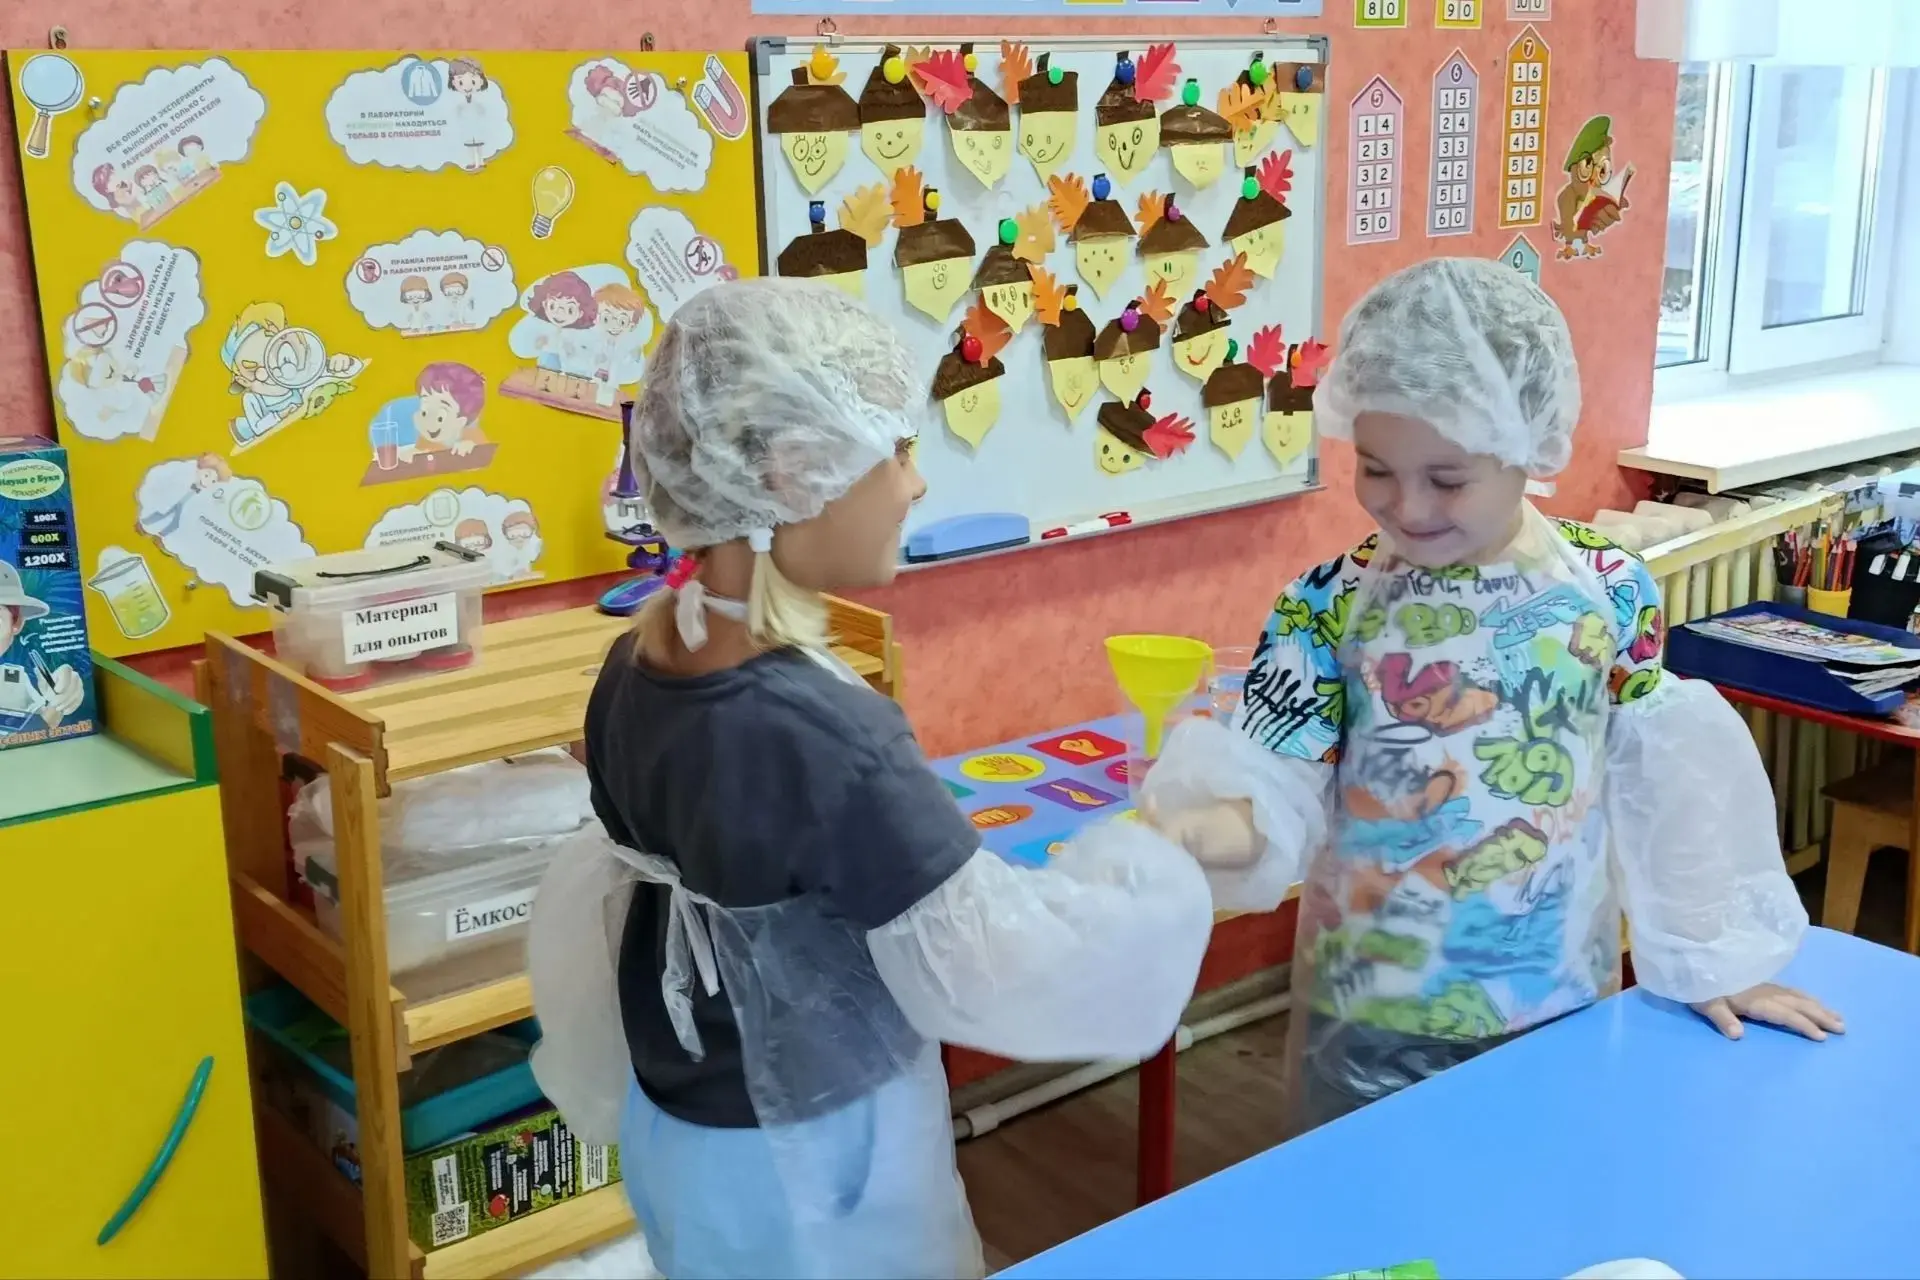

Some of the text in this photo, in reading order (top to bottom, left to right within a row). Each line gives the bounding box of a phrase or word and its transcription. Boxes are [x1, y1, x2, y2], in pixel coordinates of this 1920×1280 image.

[1368, 2, 1395, 16] 8 0
[1447, 3, 1471, 17] 9 0
[1517, 66, 1539, 79] 1 6
[1444, 92, 1467, 106] 1 5
[1515, 89, 1538, 103] 2 5
[121, 119, 151, 143] ОПЫТЫ
[151, 115, 158, 123] И
[158, 75, 216, 118] ЭКСПЕРИМЕНТЫ
[170, 100, 199, 122] ТОЛЬКО
[199, 94, 206, 102] С
[368, 110, 425, 118] ЛАБОРАТОРИИ
[170, 97, 221, 136] ВОСПИТАТЕЛЯ
[1443, 117, 1465, 130] 2 4
[1514, 113, 1537, 126] 3 4
[1363, 118, 1390, 133] 1 4
[1442, 140, 1465, 154] 3 3
[1512, 136, 1535, 149] 4 3
[1362, 143, 1389, 157] 2 3
[1440, 164, 1464, 177] 4 2
[1511, 159, 1534, 172] 5 2
[1361, 167, 1388, 183] 3 2
[1440, 188, 1461, 201] 5 1
[1510, 182, 1532, 195] 6 1
[1360, 192, 1386, 206] 4 1
[1439, 211, 1462, 225] 6 0
[1510, 204, 1532, 218] 7 0
[1359, 216, 1387, 231] 5 0
[390, 254, 468, 266] ПРАВИЛА ПОВЕДЕНИЯ
[390, 265, 441, 275] ЛАБОРАТОРИИ
[442, 264, 457, 272] ДЛЯ
[125, 301, 150, 350] ЗАПРЕЩЕНО
[146, 262, 164, 302] НЮХАТЬ
[133, 252, 179, 359] ПРОБОВАТЬ НЕЗНАКОМЫЕ
[154, 291, 176, 336] ВЕЩЕСТВА
[238, 552, 258, 568] СОБО
[355, 602, 438, 626] Материал
[352, 627, 448, 656] для опытов
